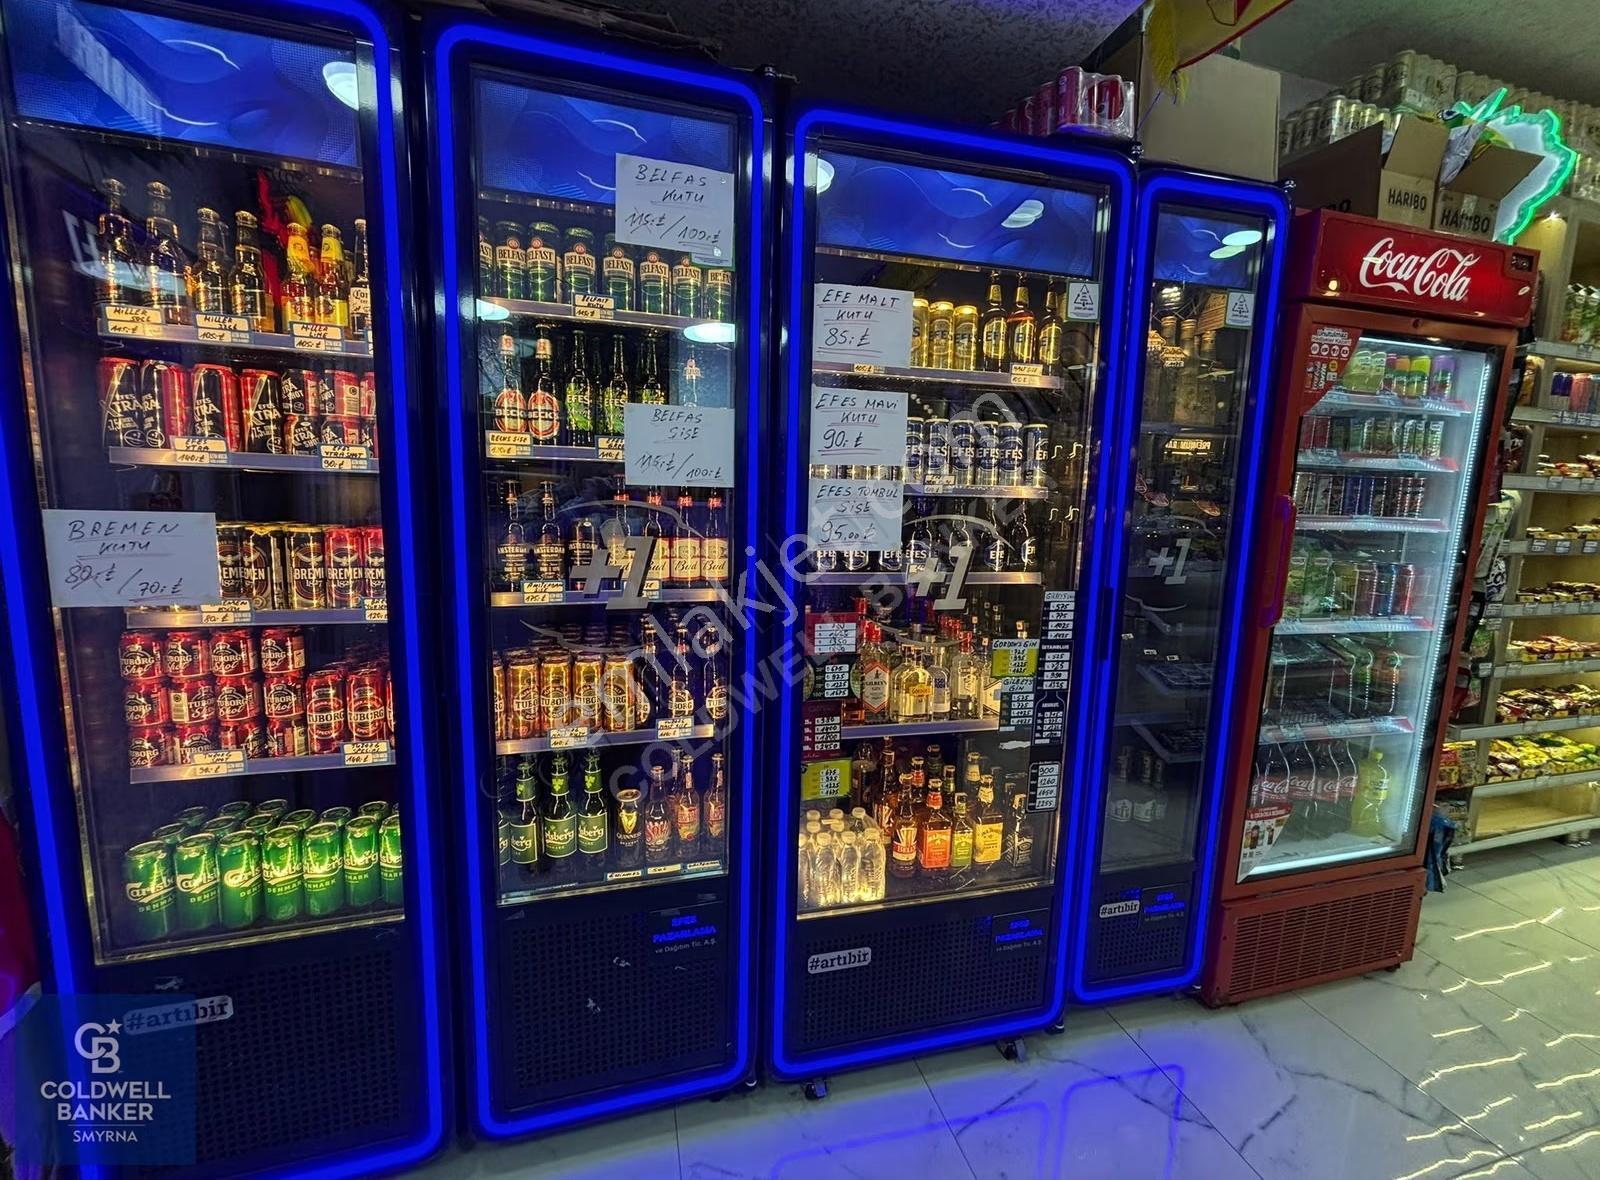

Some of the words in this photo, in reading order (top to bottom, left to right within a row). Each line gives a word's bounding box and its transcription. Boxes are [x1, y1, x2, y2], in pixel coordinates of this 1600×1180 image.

[635, 164, 706, 186] BELFAS
[662, 189, 704, 203] KUTU
[1388, 188, 1427, 211] HARIBO
[1440, 209, 1490, 233] HARIBO
[498, 251, 526, 262] BELFAS
[566, 256, 595, 268] BELFAST
[605, 260, 633, 272] BELFAST
[641, 264, 669, 276] BELFAST
[674, 267, 700, 278] BELFAST
[823, 289, 852, 303] EFE
[858, 293, 900, 308] MALT
[836, 309, 873, 320] KUTU
[566, 394, 591, 404] EFES
[815, 393, 857, 409] EFES
[650, 408, 702, 423] BELFAS
[841, 412, 878, 424] KUTU
[906, 445, 923, 455] FES
[977, 448, 999, 459] EFES
[1000, 448, 1023, 459] EFES
[817, 484, 852, 498] EFES
[858, 486, 898, 498] TOMBUL
[68, 520, 179, 541] BREMEN
[674, 560, 698, 570] Bud
[703, 560, 725, 571] Bud
[328, 568, 363, 580] BREMEN
[365, 568, 385, 580] BREM
[308, 711, 344, 723] TUBORG
[349, 709, 384, 721] TUBORG
[190, 889, 217, 903] DENM
[139, 895, 175, 912] DENMA
[808, 949, 869, 972] #artıbir
[125, 1000, 230, 1031] #artıbir
